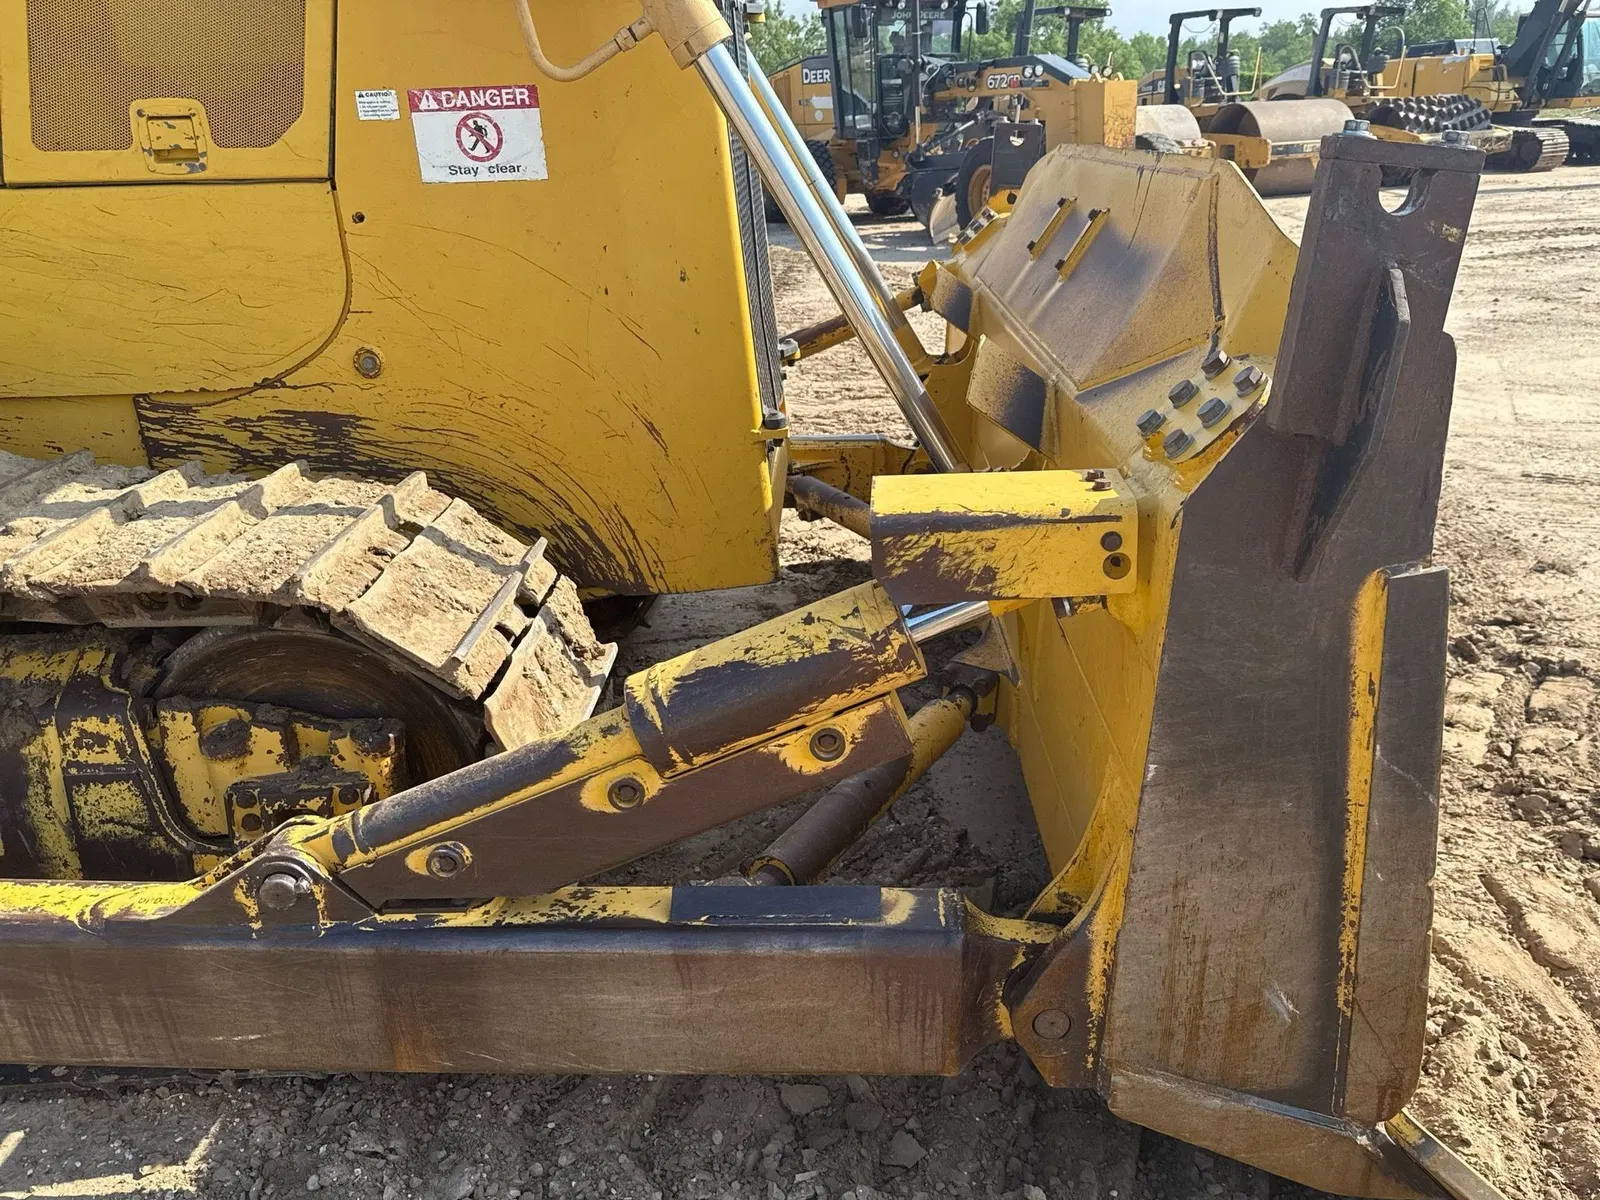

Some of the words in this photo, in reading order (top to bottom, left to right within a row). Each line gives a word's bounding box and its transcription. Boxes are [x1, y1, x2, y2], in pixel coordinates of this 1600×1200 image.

[440, 88, 531, 108] DANGER
[448, 164, 479, 177] Stay
[487, 163, 522, 174] clear
